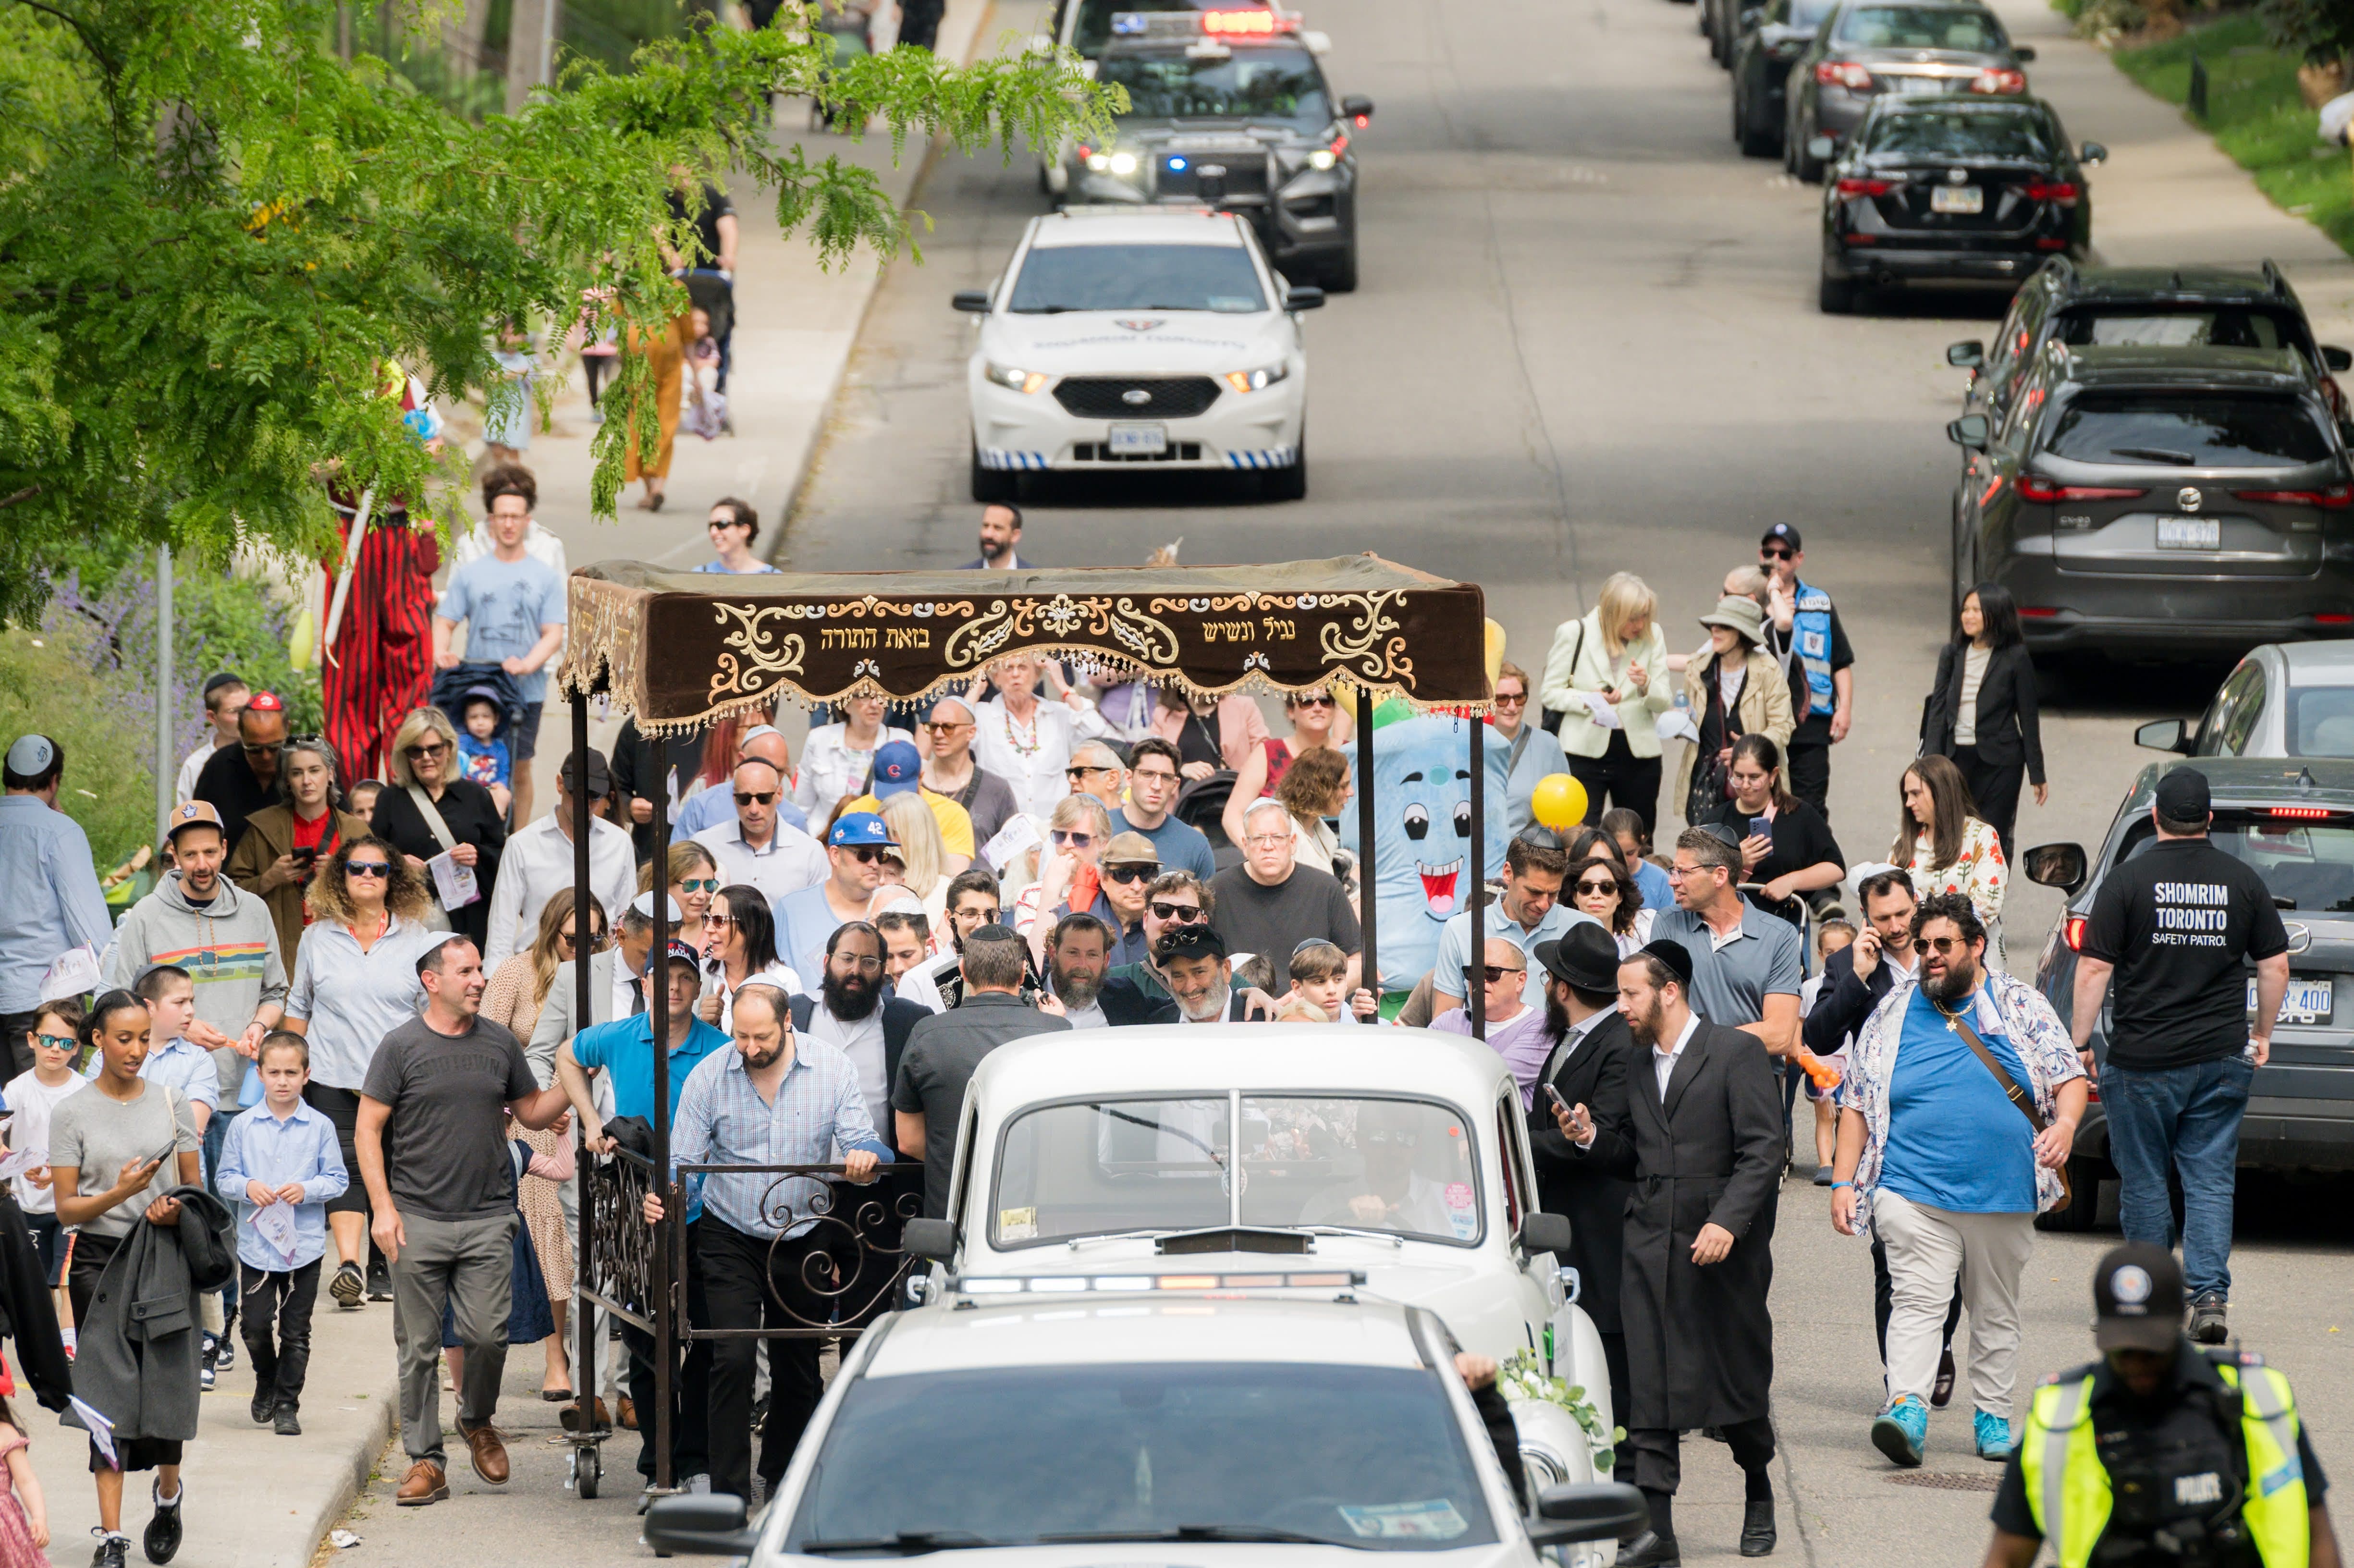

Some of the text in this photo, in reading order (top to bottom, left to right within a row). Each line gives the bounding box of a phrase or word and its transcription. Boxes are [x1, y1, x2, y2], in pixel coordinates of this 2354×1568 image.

[821, 627, 930, 649] בזאת התורה
[1202, 616, 1296, 642] נגיל ונשיש
[887, 764, 901, 777] C
[867, 821, 884, 835] 42
[2154, 882, 2229, 906] SHOMRIM
[2155, 907, 2227, 931] TORONTO
[2152, 932, 2227, 947] SAFETY PATROL
[668, 948, 691, 959] NADA
[2249, 987, 2330, 1011] CR 400
